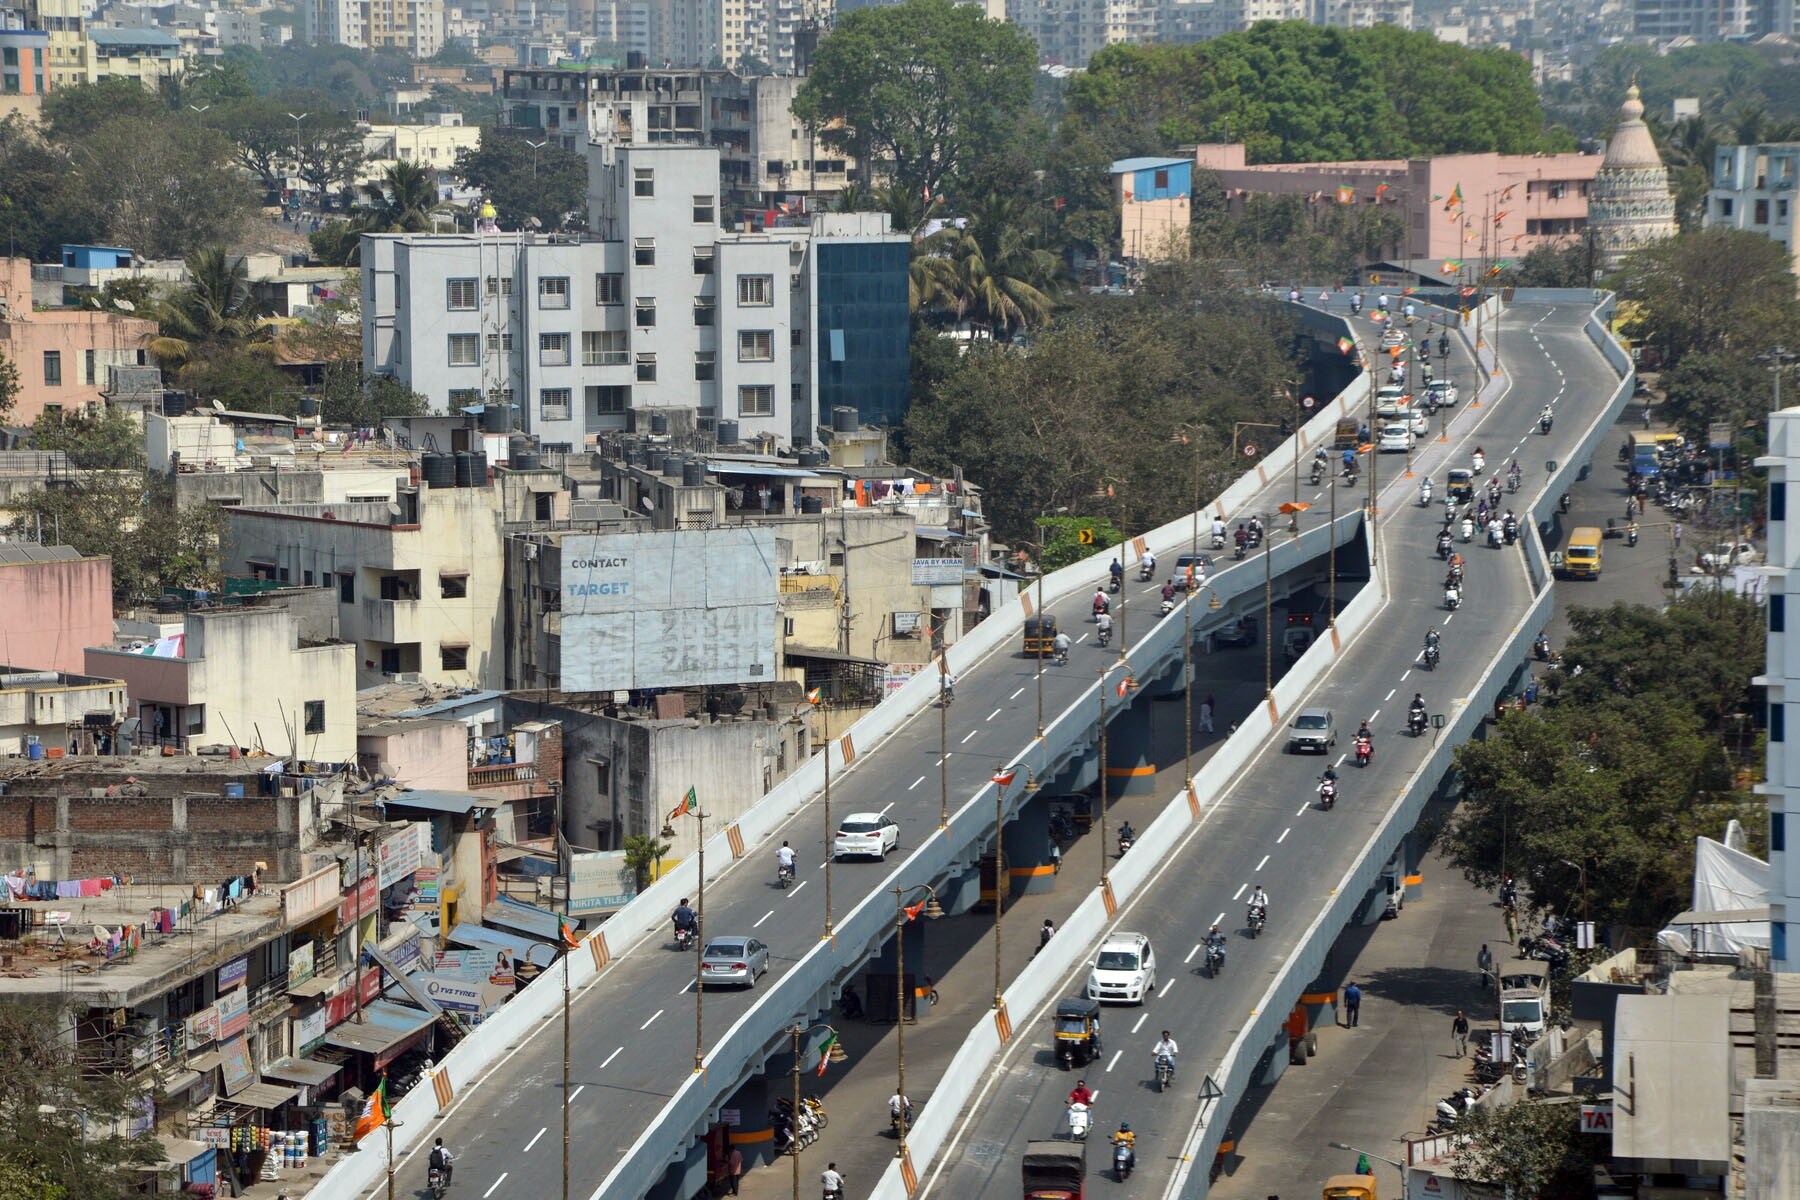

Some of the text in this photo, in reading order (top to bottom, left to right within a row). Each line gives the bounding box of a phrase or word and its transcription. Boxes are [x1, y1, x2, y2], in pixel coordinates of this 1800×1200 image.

[571, 558, 628, 569] CONTACT
[567, 581, 629, 596] TARGET
[571, 895, 628, 909] NIKITA TILES
[454, 989, 477, 998] TYRES
